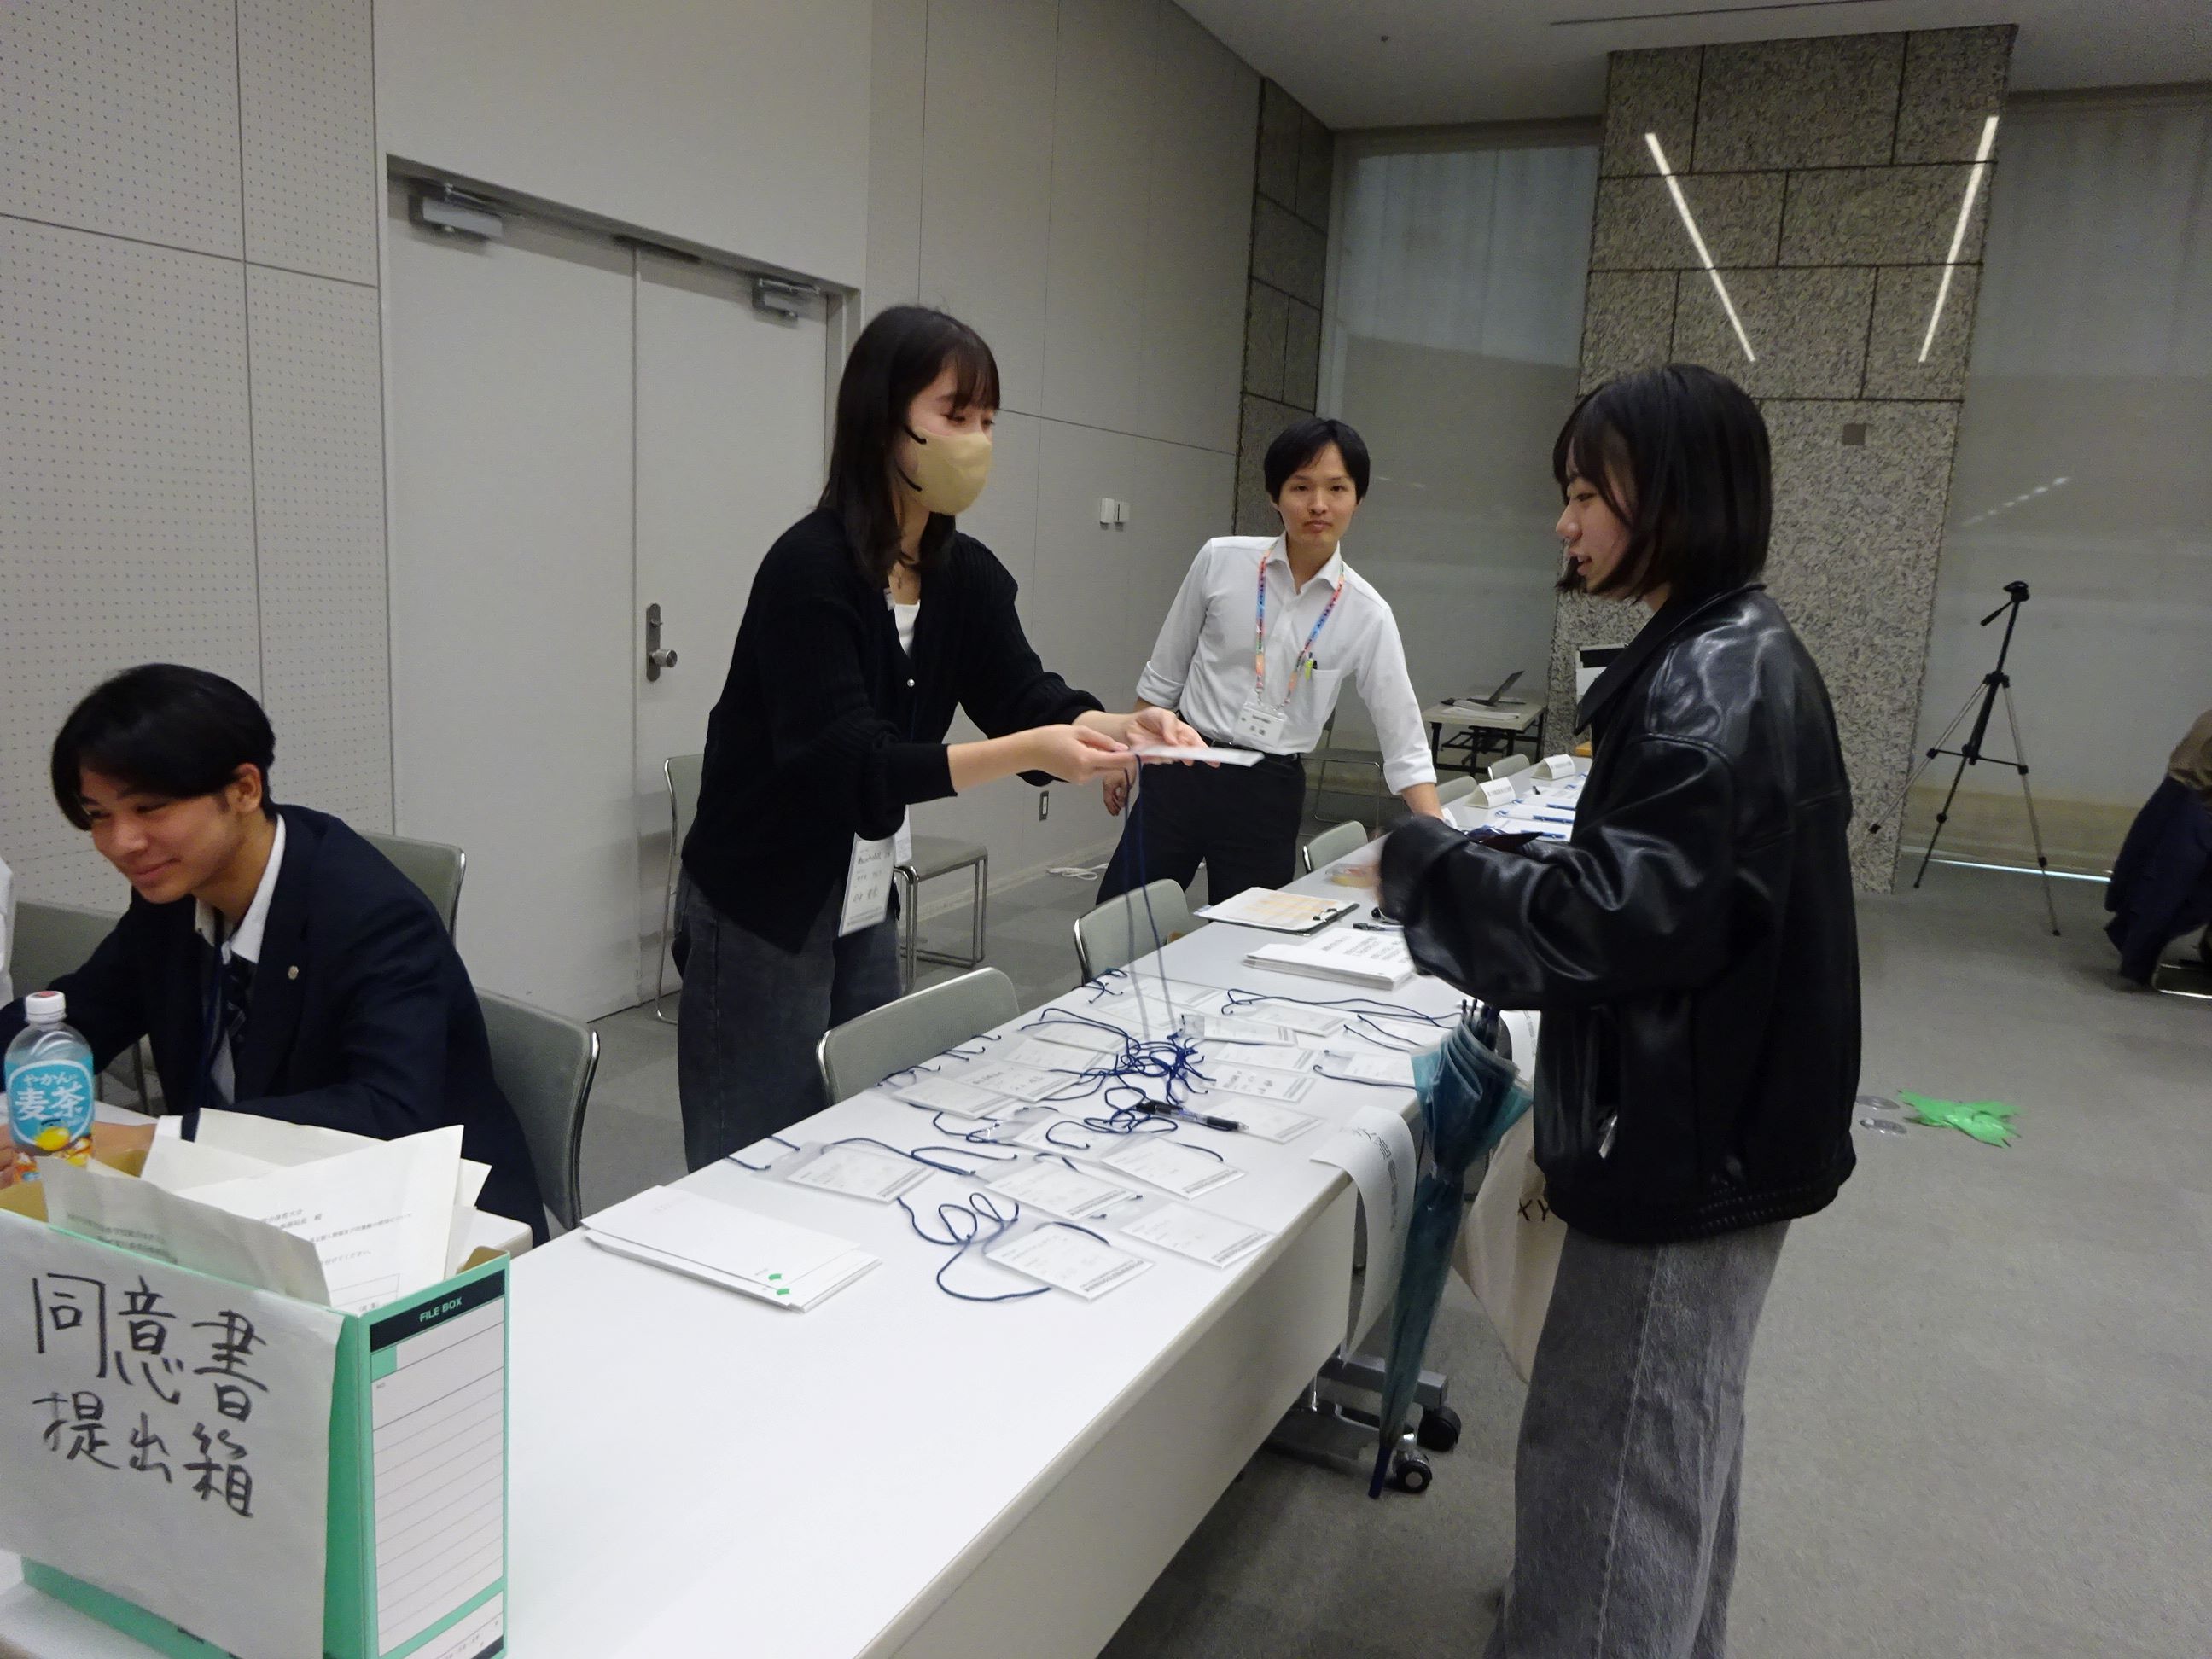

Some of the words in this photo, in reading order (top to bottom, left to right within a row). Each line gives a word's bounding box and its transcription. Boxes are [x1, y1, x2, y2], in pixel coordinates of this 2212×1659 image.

[15, 1080, 85, 1121] 麦茶
[32, 1272, 270, 1423] 同意書
[419, 1307, 441, 1323] FILE
[442, 1296, 463, 1313] BOX
[32, 1390, 254, 1518] 提出箱
